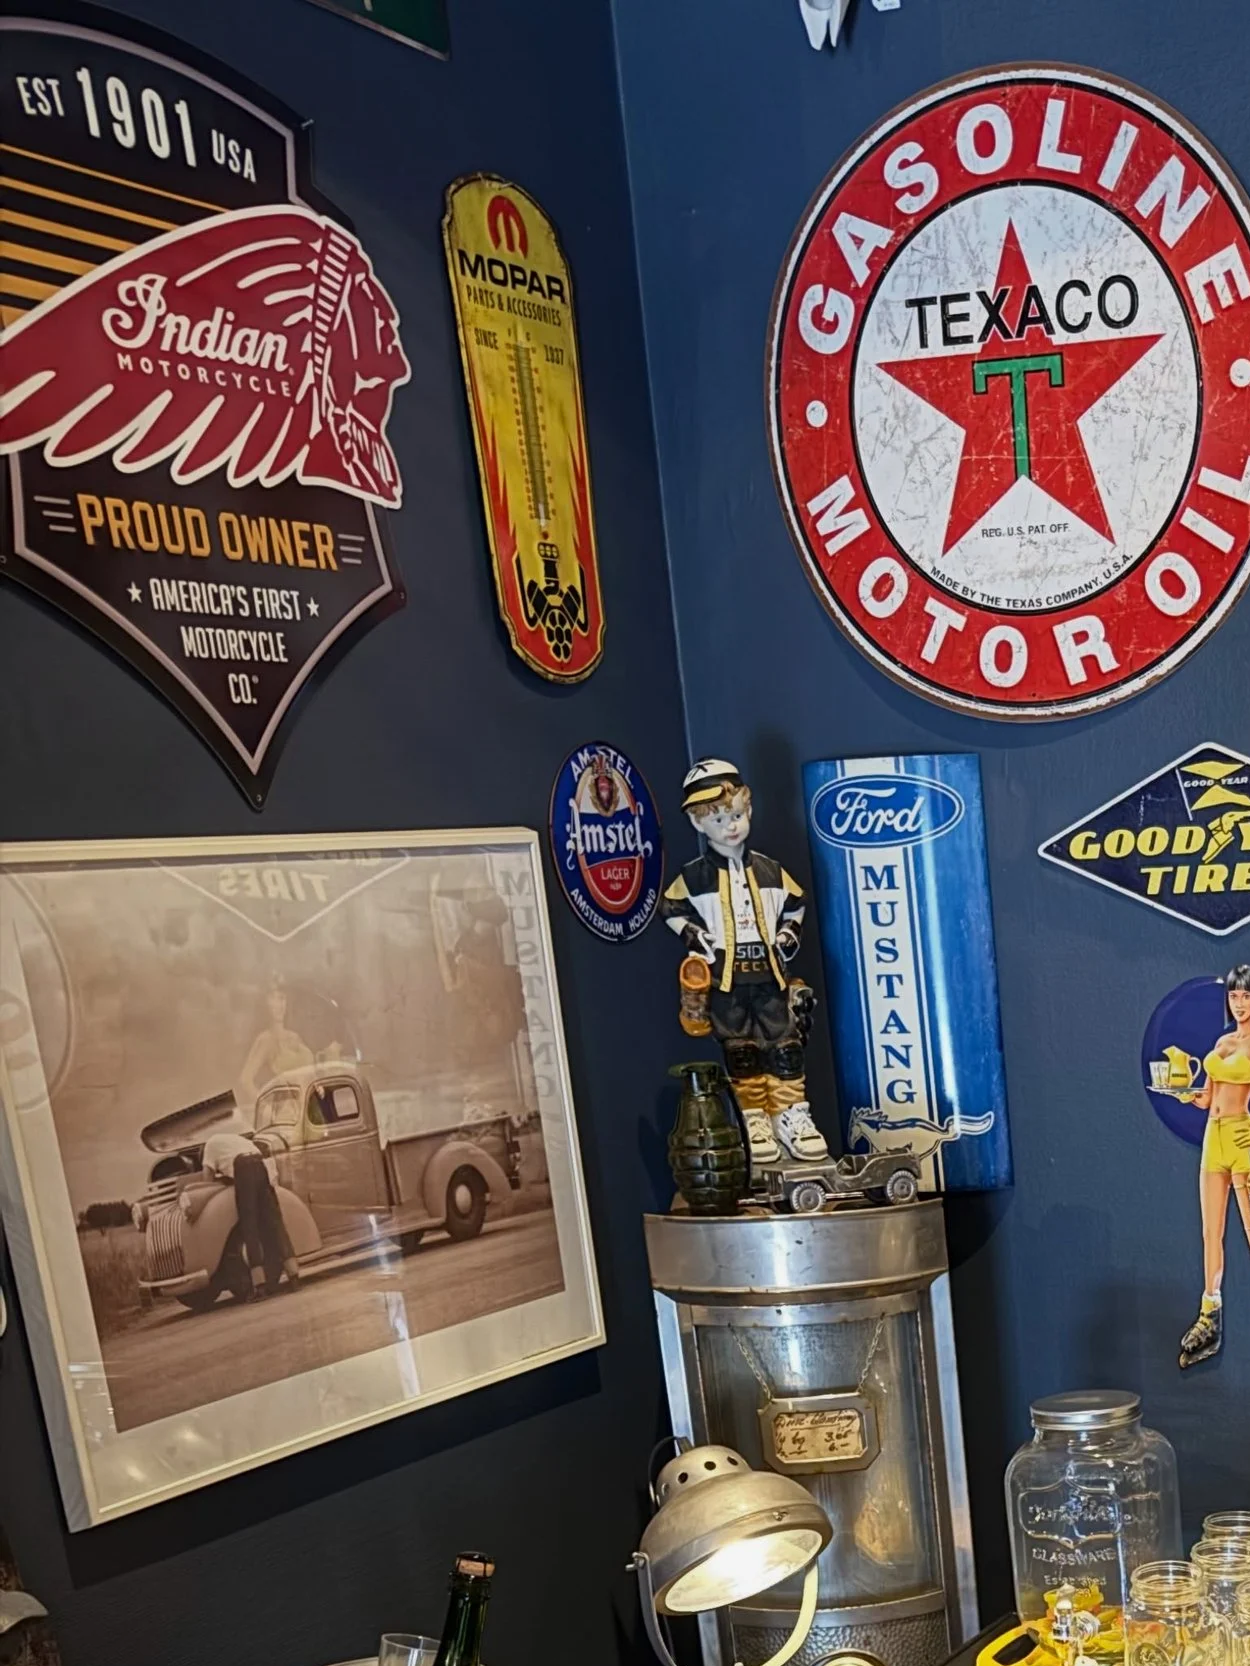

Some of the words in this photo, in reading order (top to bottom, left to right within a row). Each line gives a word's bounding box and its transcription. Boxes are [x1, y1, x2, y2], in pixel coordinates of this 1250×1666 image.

[16, 76, 65, 117] EST
[76, 67, 197, 168] 1901
[211, 129, 257, 183] USA
[457, 248, 568, 304] MOPAR
[101, 273, 290, 373] Indian
[466, 284, 495, 310] PARTS
[498, 294, 505, 312] &
[507, 296, 562, 327] ACCESSORIES
[904, 273, 1140, 349] TEXACO
[473, 327, 499, 351] SINCE
[117, 352, 292, 398] MOTORCYCLE
[76, 493, 212, 558] PROUD
[217, 511, 338, 572] OWNER
[981, 527, 1005, 538] REG.
[1007, 526, 1025, 536] U.S.
[149, 578, 250, 618] AMERICA'S
[252, 587, 301, 621] FIRST
[806, 474, 1120, 688] MOTOR
[930, 566, 959, 592] MADE
[961, 586, 977, 599] BY
[979, 591, 1002, 607] THE
[1005, 595, 1043, 609] TEXAS
[1045, 577, 1104, 607] COMPANY,
[1103, 553, 1134, 581] U.S.A.
[180, 625, 289, 664] MOTORCYCLE
[1183, 779, 1214, 788] GOOD
[1220, 776, 1249, 786] YEAR
[566, 797, 654, 871] Amstel
[830, 787, 926, 836] Ford
[1069, 825, 1206, 860] GOOD
[600, 866, 631, 881] LAGER
[570, 887, 626, 938] AMSTERDAM
[627, 888, 657, 934] HOLLAND
[860, 864, 918, 1104] MUSTANG
[1032, 1548, 1116, 1566] GLASSWARE
